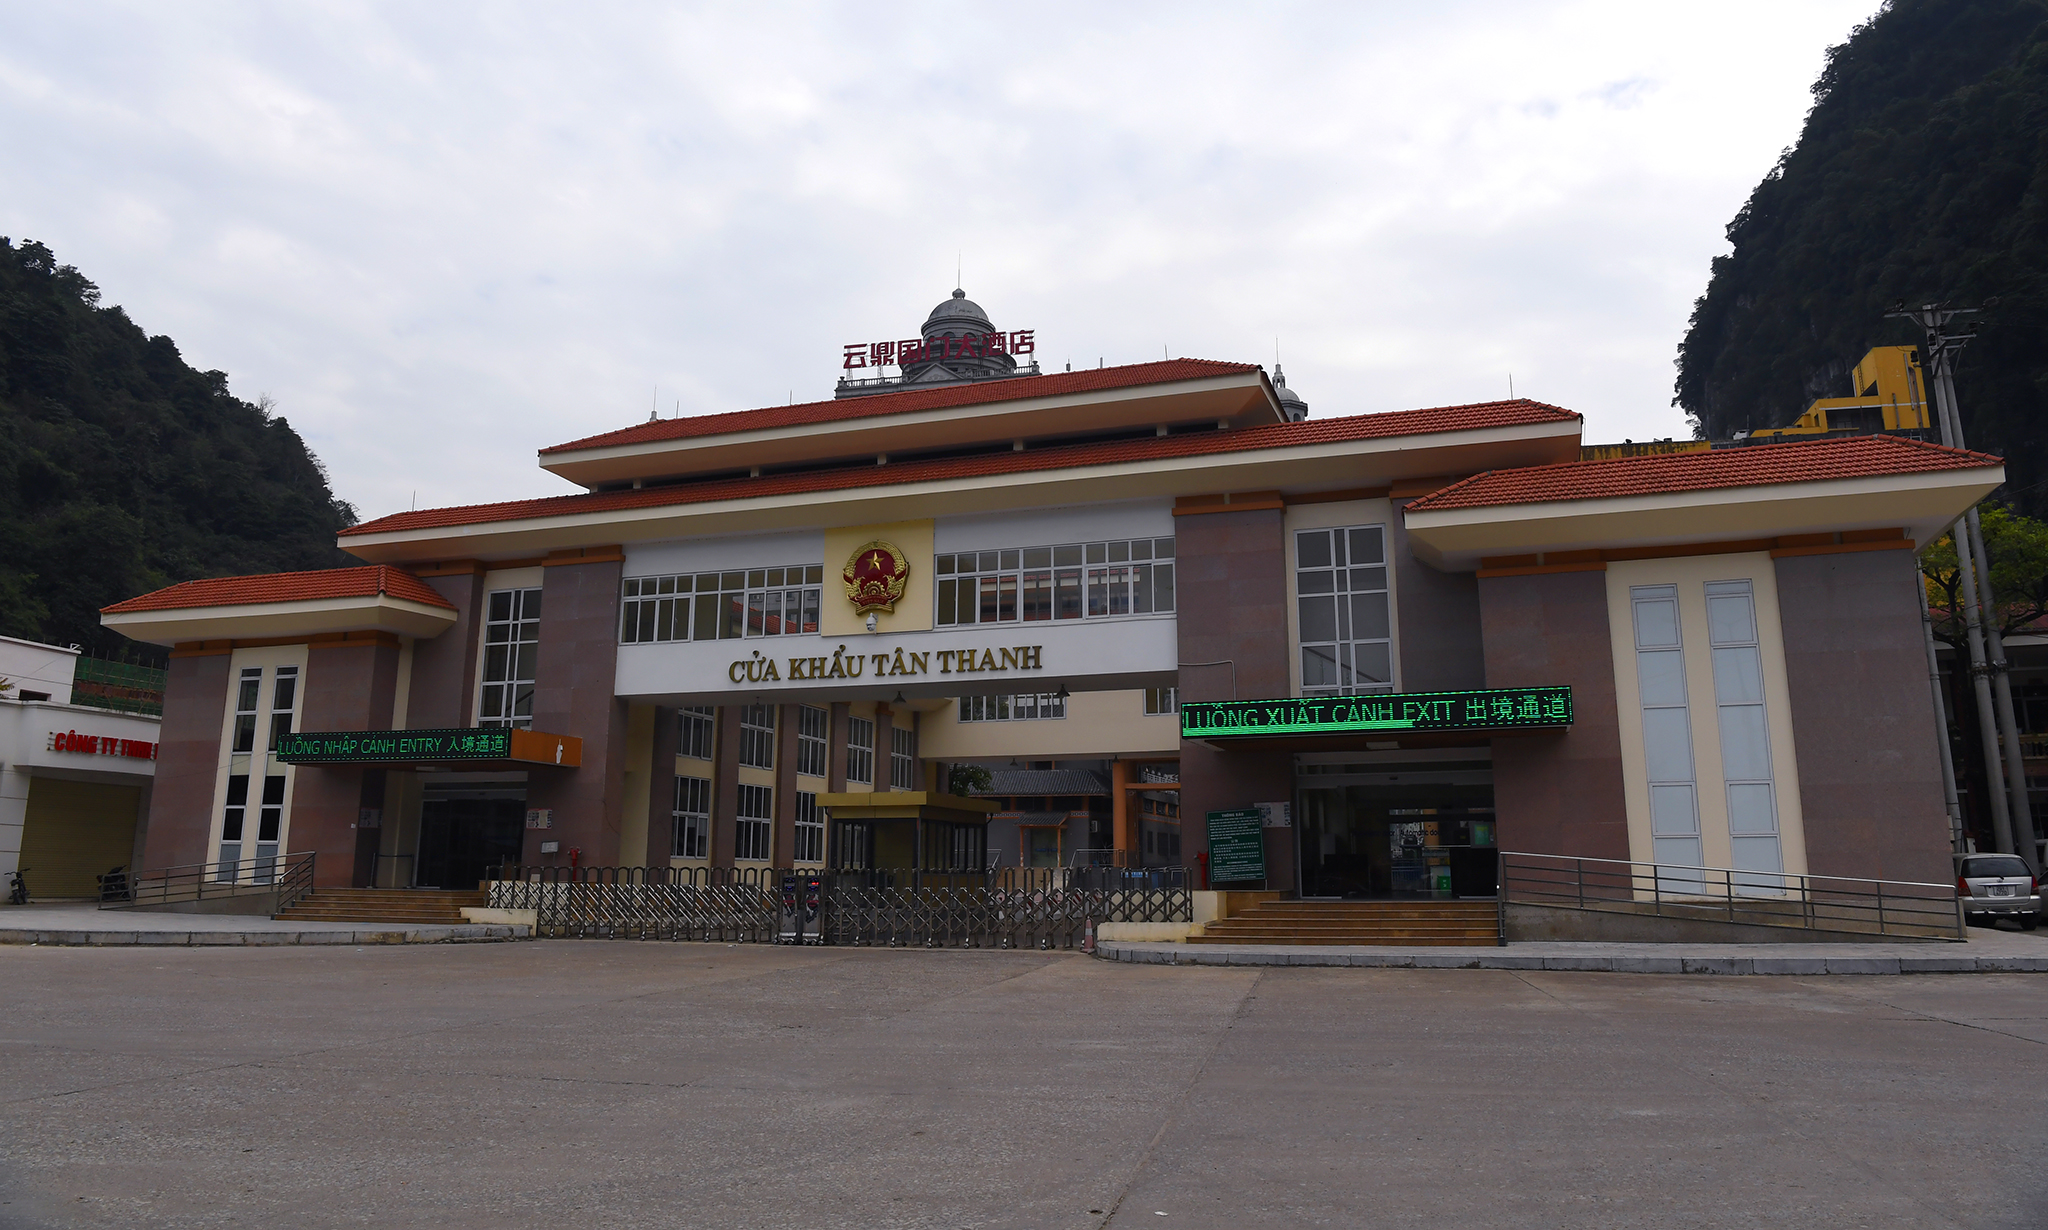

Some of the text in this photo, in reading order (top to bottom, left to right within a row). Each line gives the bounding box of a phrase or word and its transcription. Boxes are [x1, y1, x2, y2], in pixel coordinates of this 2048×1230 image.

[843, 329, 1035, 368] 云鼎国门大酒店
[728, 644, 1043, 683] CỬA KHẨU TÂN THANH
[1402, 700, 1456, 722] EXIT
[1466, 693, 1568, 721] 出境通道
[55, 729, 98, 753] CÔNG
[102, 737, 118, 755] TY
[279, 736, 321, 755] LUỒNG
[323, 735, 358, 757] NHẬP
[399, 737, 443, 753] ENTRY
[446, 734, 505, 753] 入境通道
